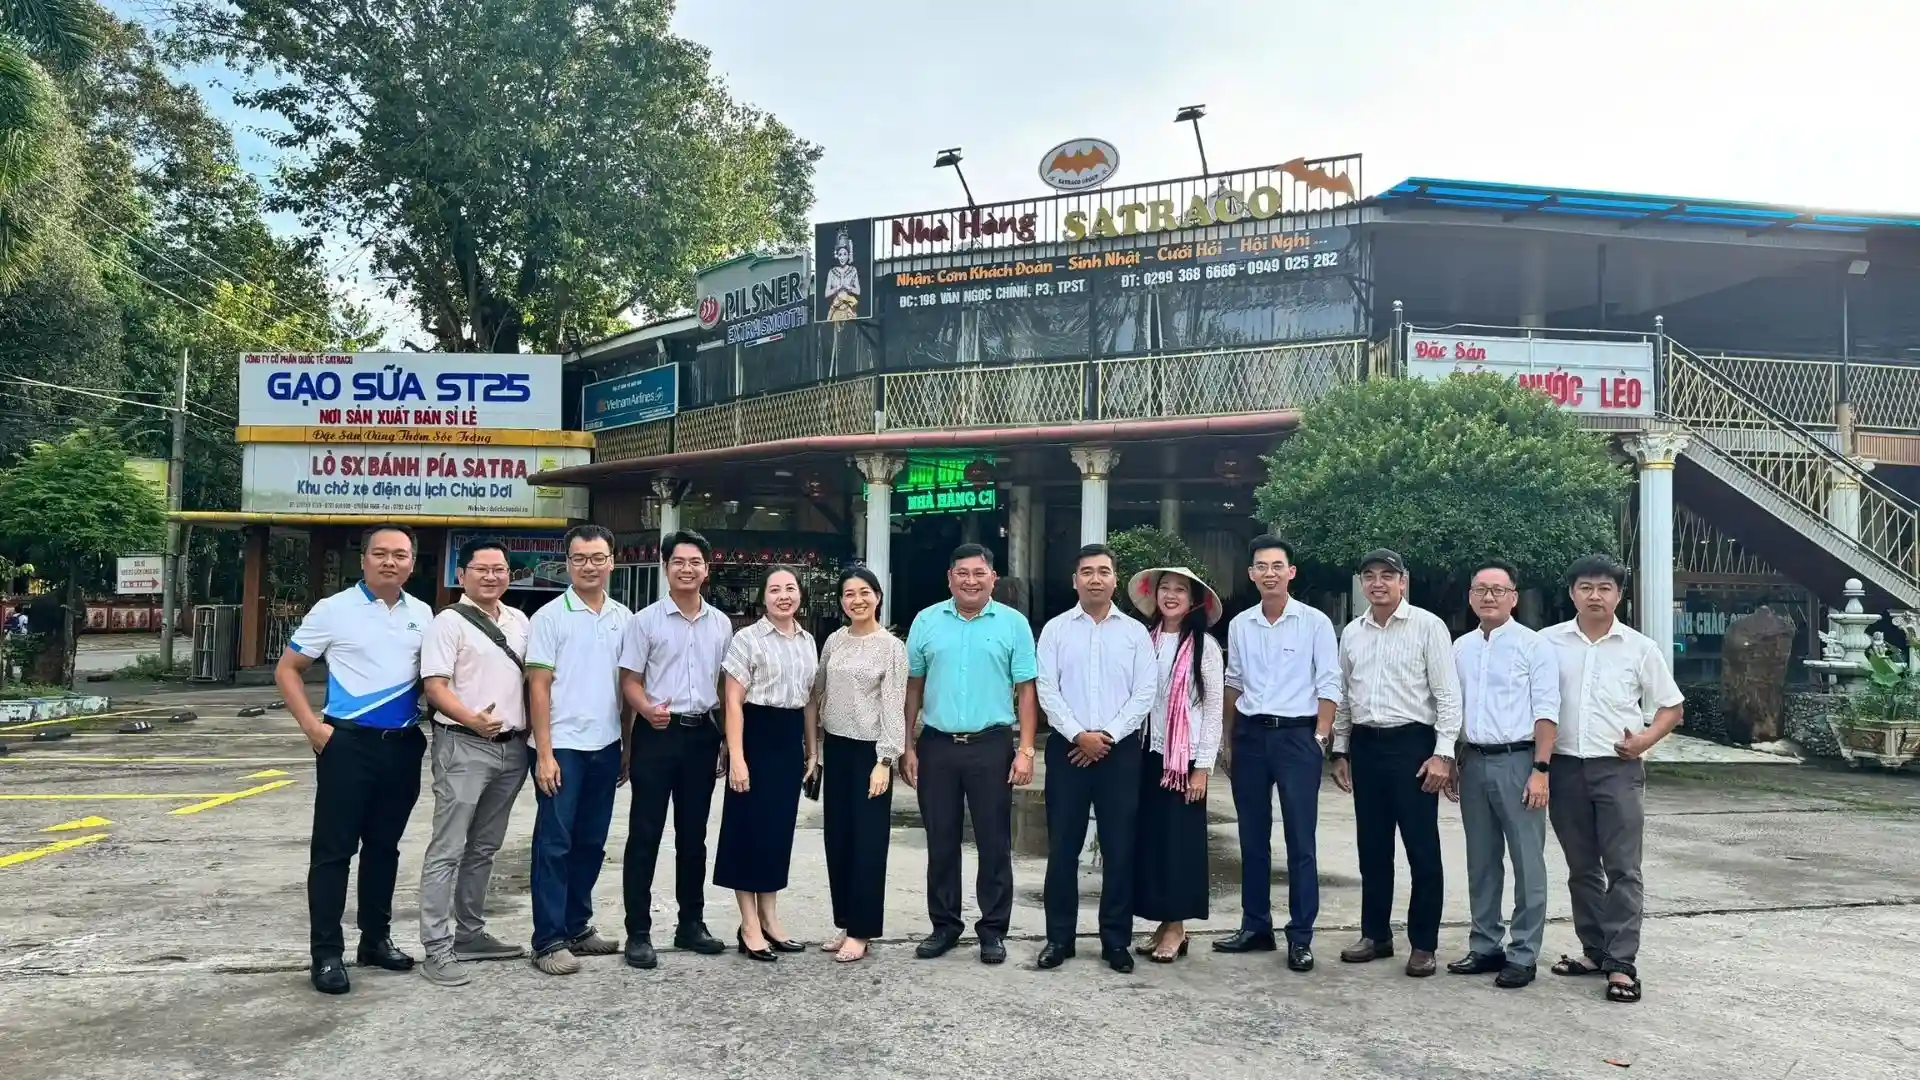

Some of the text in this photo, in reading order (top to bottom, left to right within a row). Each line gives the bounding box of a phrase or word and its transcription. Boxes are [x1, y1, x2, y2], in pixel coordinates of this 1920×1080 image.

[1063, 185, 1282, 241] SATRACO
[892, 211, 1038, 246] Nhà Hàng
[896, 273, 935, 288] Nhận:
[937, 270, 968, 283] Cơm
[970, 265, 1013, 280] Khách
[1015, 260, 1053, 276] Đoàn
[1068, 254, 1102, 270] Sinh
[1104, 250, 1141, 268] Nhật
[1157, 244, 1192, 261] Cưới
[1240, 237, 1268, 255] Hội
[1271, 232, 1310, 253] Nghị
[1121, 252, 1338, 288] ĐT: 0299 368 6666 0949 025 282
[724, 271, 805, 321] PILSNER
[940, 288, 960, 304] VĂN
[963, 288, 993, 304] NGỌC
[996, 282, 1031, 299] CHÍNH,
[1035, 283, 1053, 297] P3,
[1057, 279, 1085, 294] TPST
[727, 306, 808, 344] EXTRA SMOOTH
[245, 353, 260, 364] CÔNG
[261, 355, 270, 364] TY
[325, 355, 353, 364] SATRACO
[1415, 340, 1487, 360] Đặc Sản
[267, 364, 531, 406] GẠO SỮA ST25
[1600, 369, 1642, 408] LÈO
[319, 408, 341, 424] NƠI
[346, 404, 372, 424] SẢN
[377, 404, 409, 425] XUẤT
[606, 391, 654, 411] Vietnam Airlines
[312, 450, 528, 479] LÒ SX BÁNH PÍA SATRA
[297, 480, 320, 495] Khu
[353, 484, 368, 496] xe
[373, 482, 401, 500] điện
[404, 482, 421, 496] du
[425, 482, 446, 499] lịch
[450, 482, 486, 498] Chùa
[490, 484, 512, 498] Dơi
[907, 491, 935, 510] NHÀ
[937, 489, 976, 508] HÀNG
[1696, 606, 1726, 635] CHÀO
